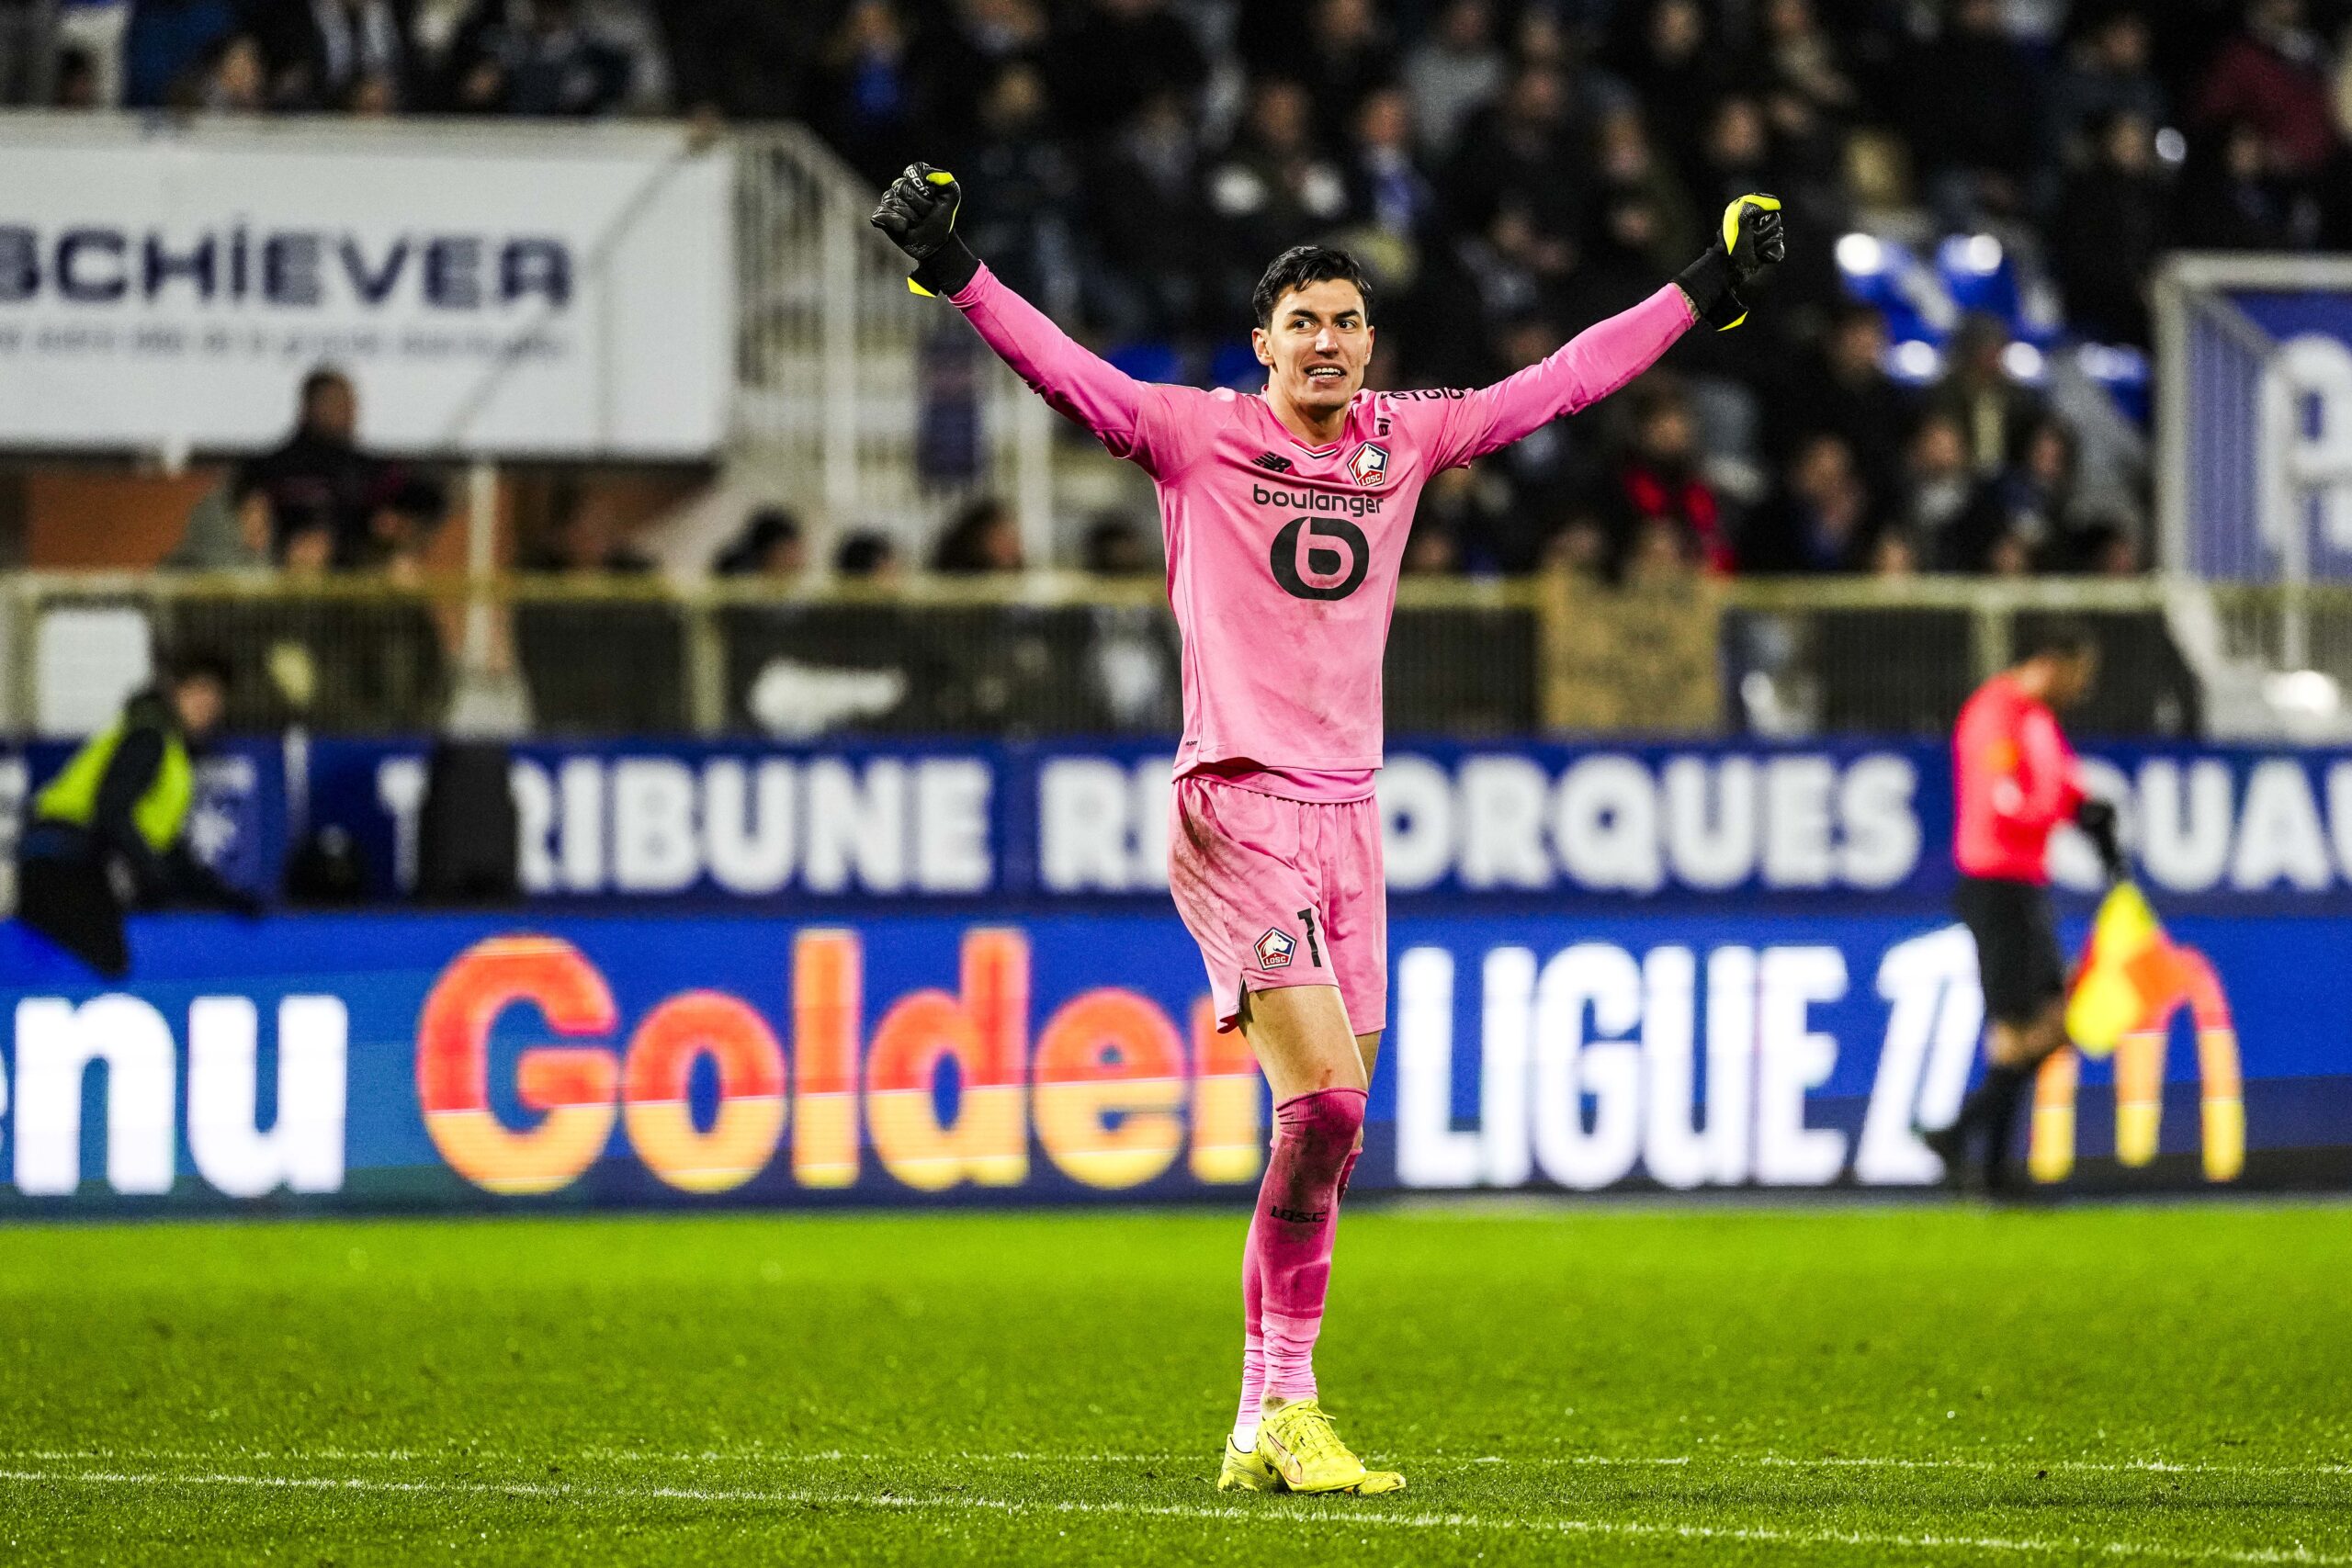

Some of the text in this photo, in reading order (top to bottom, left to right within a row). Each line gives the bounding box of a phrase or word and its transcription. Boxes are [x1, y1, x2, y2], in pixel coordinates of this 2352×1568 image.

[1362, 473, 1381, 486] LOSC
[1253, 484, 1384, 517] boulanger
[1297, 908, 1321, 967] 1
[1266, 956, 1286, 965] LOSC
[0, 992, 349, 1197] nu
[1395, 942, 1849, 1190] LIGUE
